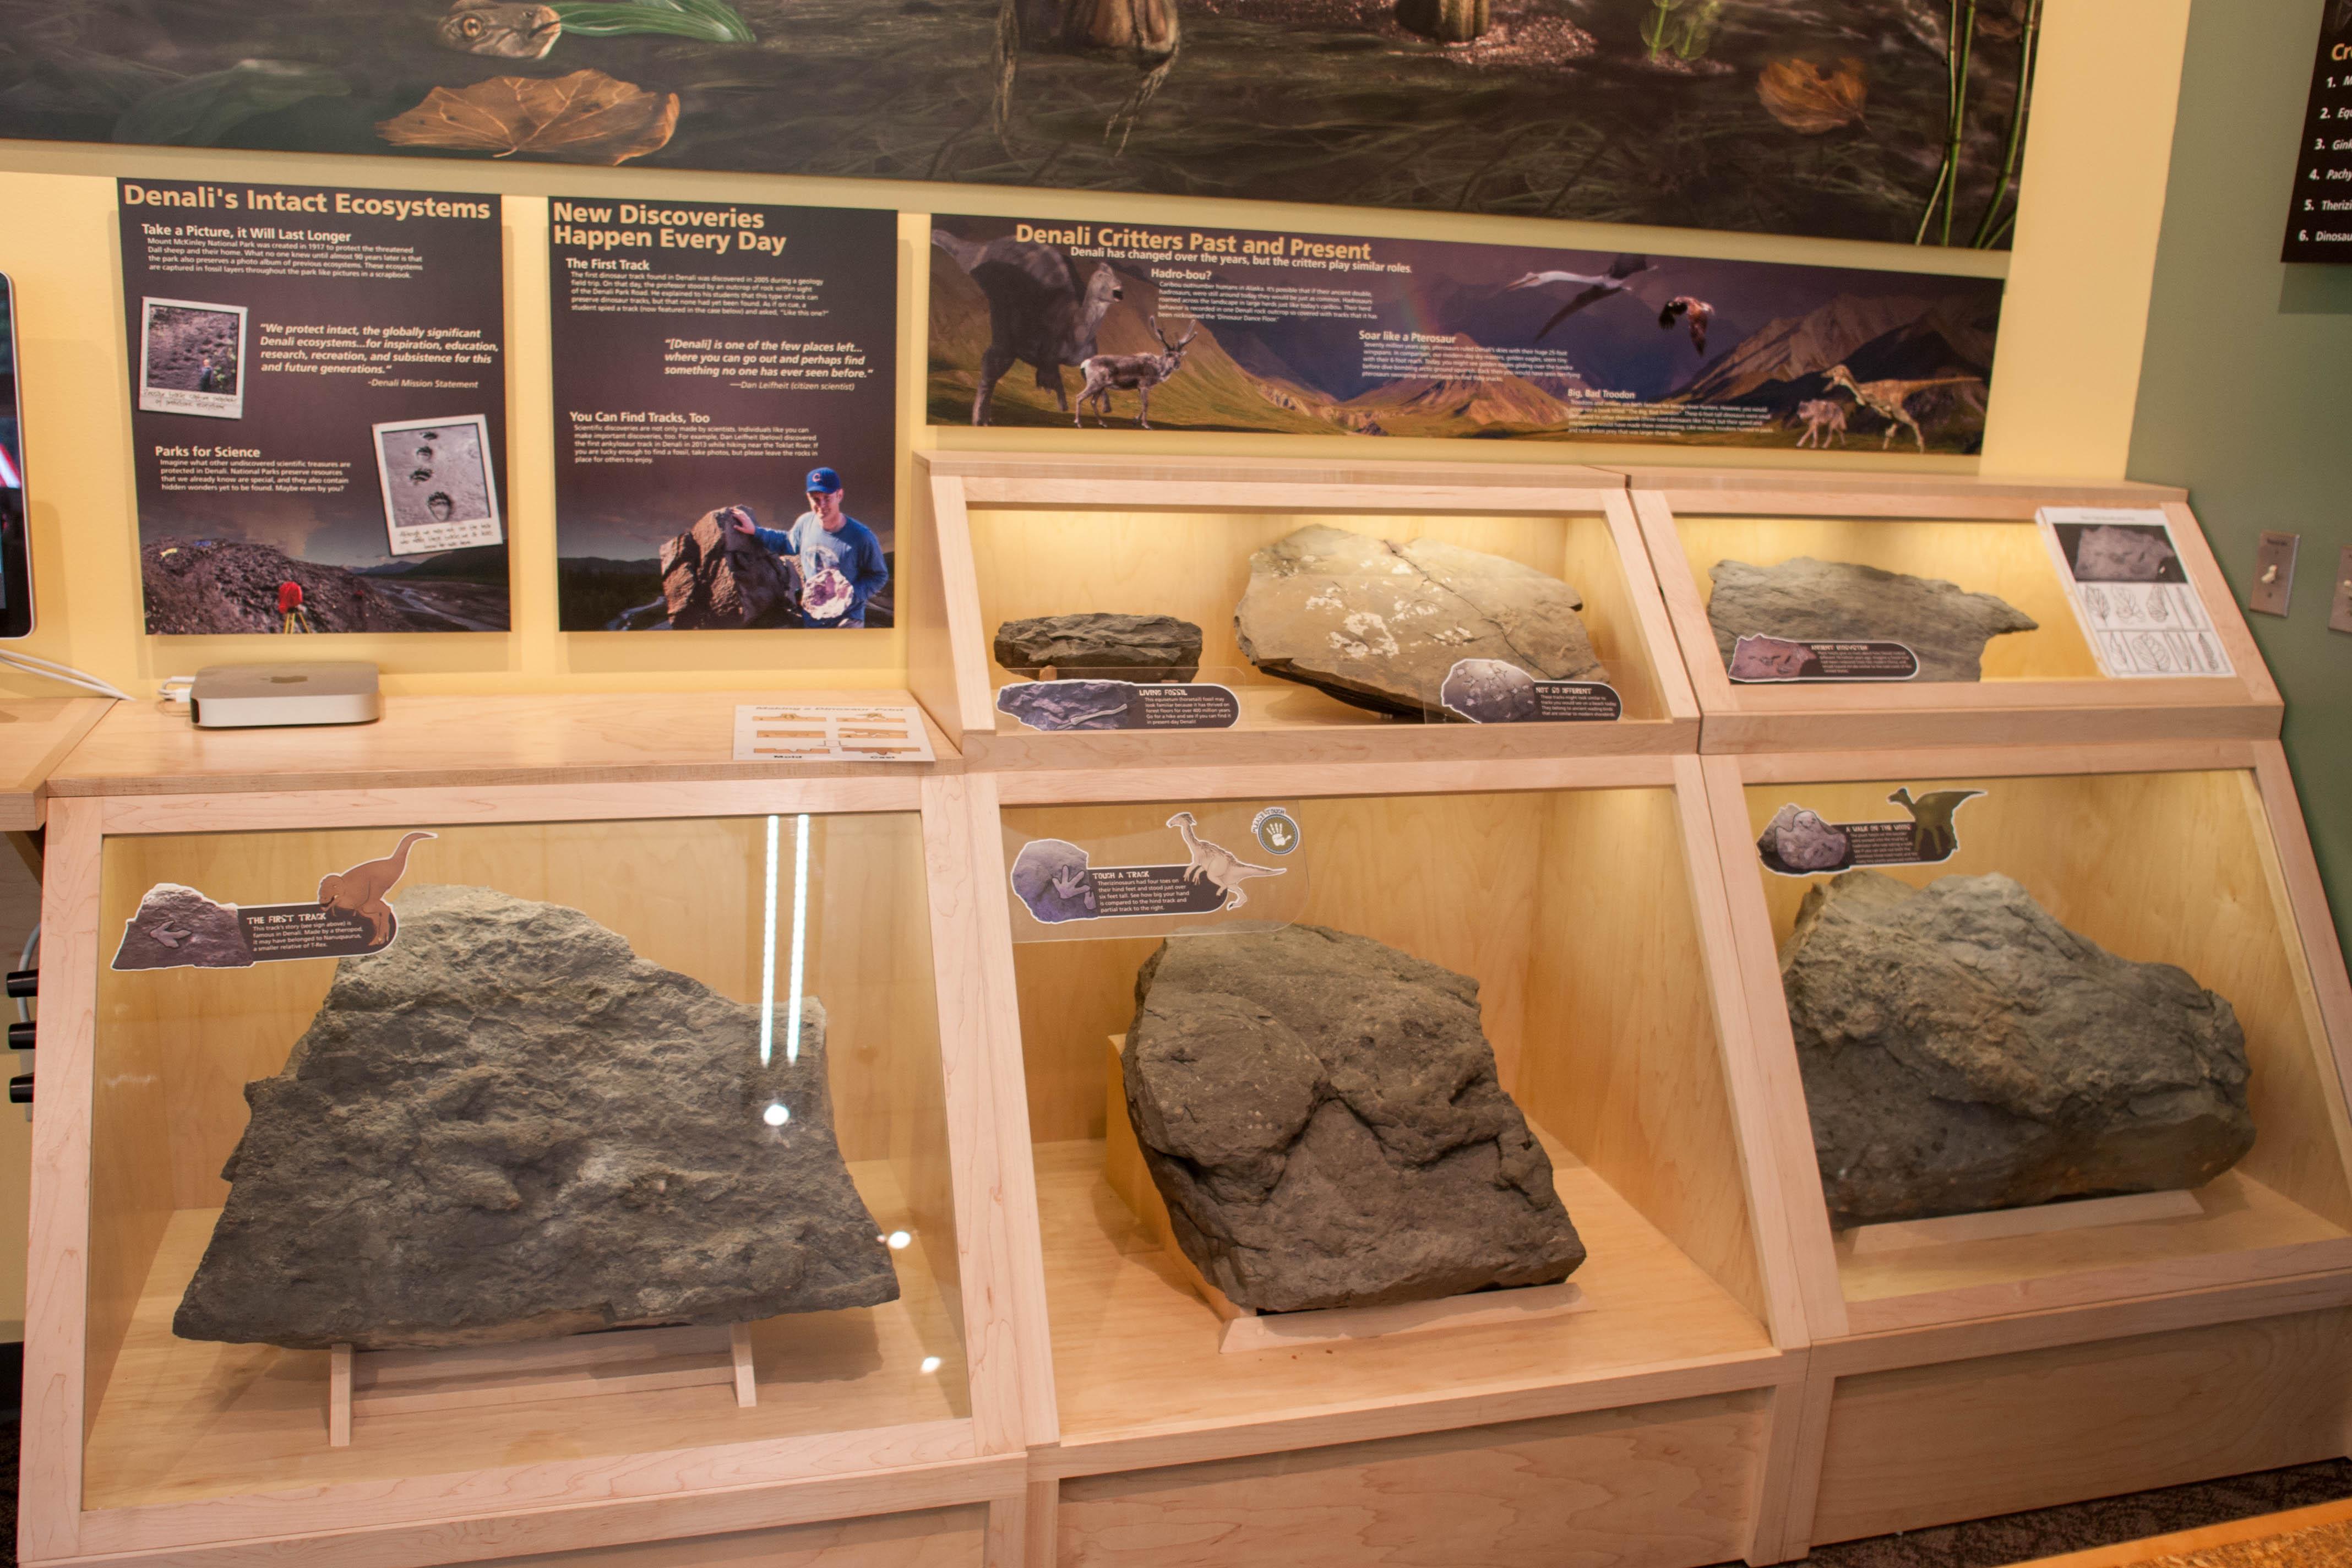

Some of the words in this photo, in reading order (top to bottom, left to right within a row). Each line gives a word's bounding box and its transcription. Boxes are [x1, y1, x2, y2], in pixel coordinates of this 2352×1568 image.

[2332, 43, 2352, 61] Cr
[2327, 77, 2336, 88] 1.
[2320, 107, 2331, 119] 2.
[2314, 138, 2325, 150] 3.
[2309, 168, 2320, 180] 4.
[124, 184, 238, 209] Denali's
[247, 189, 328, 213] Intact
[335, 193, 491, 221] Ecosystems
[2304, 199, 2315, 210] 5.
[554, 202, 612, 223] New
[620, 204, 764, 228] Discoveries
[141, 224, 172, 236] Take
[175, 227, 183, 236] a
[186, 225, 234, 239] Picture,
[237, 227, 247, 238] it
[249, 227, 275, 239] Will
[279, 228, 304, 241] Last
[307, 230, 351, 244] Longer
[2298, 230, 2309, 241] 6.
[554, 225, 652, 251] Happen
[660, 228, 731, 254] Every
[739, 231, 787, 257] Day
[1016, 224, 1091, 246] Denali
[1098, 228, 1183, 250] Critters
[1190, 233, 1237, 254] Past
[1243, 237, 1284, 255] and
[1291, 238, 1371, 260] Present
[565, 258, 589, 269] The
[591, 258, 617, 270] First
[619, 259, 650, 270] Track
[1071, 246, 1104, 257] Denali
[1107, 248, 1126, 258] has
[1127, 249, 1173, 263] changed
[1174, 253, 1199, 262] over
[1200, 252, 1218, 263] the
[1219, 256, 1250, 266] years,
[1253, 255, 1270, 266] but
[1272, 256, 1290, 266] the
[1291, 258, 1327, 269] critters
[1329, 259, 1351, 272] play
[1352, 260, 1385, 271] similar
[1151, 268, 1212, 280] Hadro-bou?
[285, 325, 325, 337] protect
[326, 325, 360, 336] intact,
[362, 325, 380, 336] the
[382, 326, 425, 339] globally
[427, 328, 481, 339] significant
[1359, 330, 1381, 340] Soar
[1384, 331, 1401, 341] like
[260, 336, 295, 346] Denali
[384, 339, 442, 351] inspiration,
[445, 340, 499, 352] education,
[714, 340, 722, 349] is
[747, 340, 760, 350] of
[761, 341, 778, 351] the
[781, 341, 802, 351] few
[802, 341, 834, 353] places
[260, 350, 308, 360] research,
[311, 351, 367, 362] recreation,
[369, 352, 391, 361] and
[393, 352, 453, 363] subsistence
[454, 353, 471, 363] for
[472, 353, 492, 363] this
[665, 352, 699, 362] where
[699, 355, 721, 364] you
[743, 355, 757, 365] go
[759, 355, 777, 363] out
[778, 354, 800, 364] and
[800, 355, 842, 367] perhaps
[845, 355, 865, 365] find
[261, 362, 282, 372] and
[285, 362, 318, 373] future
[665, 366, 720, 378] something
[760, 367, 778, 376] has
[401, 379, 433, 388] Mission
[434, 379, 478, 388] Statement
[820, 383, 855, 391] scientist)
[569, 411, 592, 422] You
[595, 411, 618, 422] Can
[620, 412, 645, 422] Find
[647, 412, 687, 424] Tracks,
[689, 412, 710, 423] Too
[155, 445, 189, 456] Parks
[192, 445, 211, 457] for
[214, 447, 260, 458] Science
[812, 473, 820, 482] C
[268, 914, 295, 923] FIRST
[298, 913, 326, 922] TRACK
